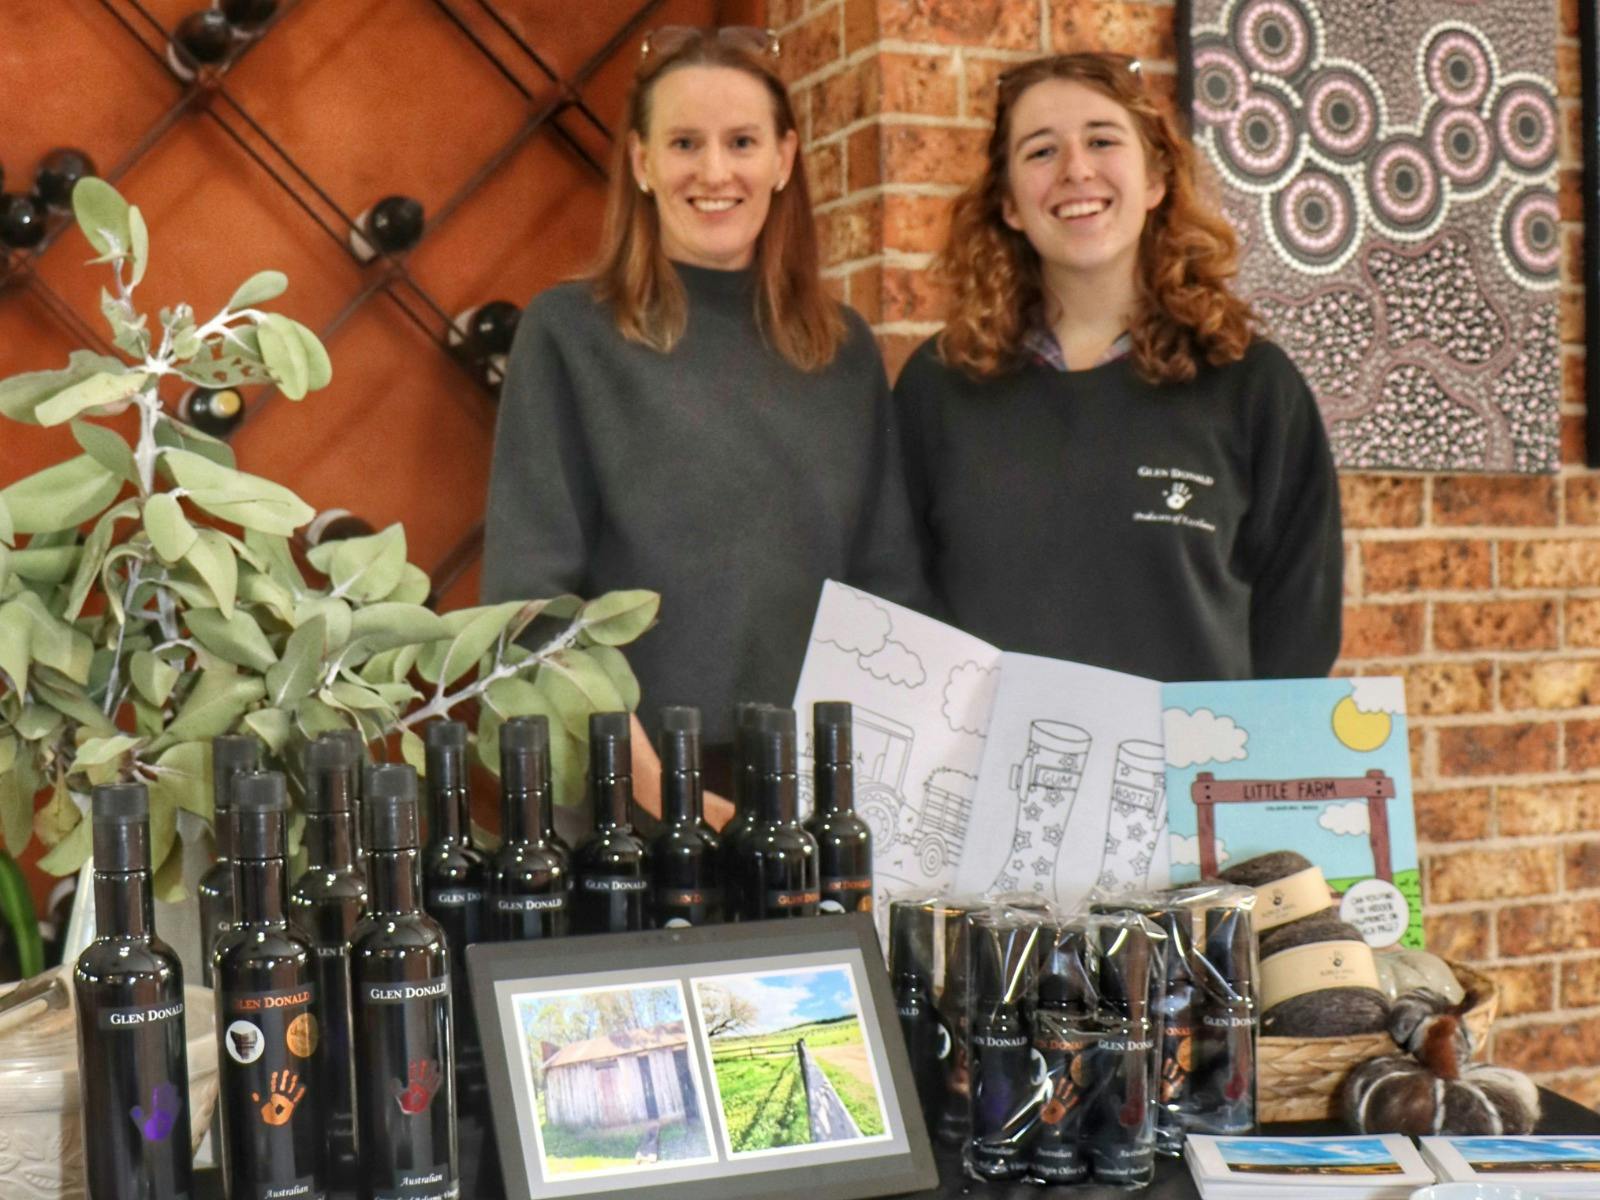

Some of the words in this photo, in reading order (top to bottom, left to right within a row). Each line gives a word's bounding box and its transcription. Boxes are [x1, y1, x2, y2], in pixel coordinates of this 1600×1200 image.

[1041, 771, 1073, 787] GUM
[1242, 782, 1288, 799] LITTLE
[1296, 780, 1338, 799] FARM
[585, 880, 610, 889] GLEN
[611, 880, 647, 890] DONALD
[439, 893, 465, 903] GLEN
[498, 900, 523, 909] GLEN
[525, 898, 562, 910] DONALD
[370, 988, 403, 999] GLEN
[405, 983, 446, 998] DONALD
[264, 991, 311, 1009] DONALD
[110, 1013, 145, 1024] GLEN
[147, 1003, 183, 1022] DONALD
[986, 1037, 1028, 1047] DONALD
[1098, 1041, 1125, 1051] GLEN
[400, 1173, 443, 1187] Australian
[264, 1185, 309, 1200] Australian
